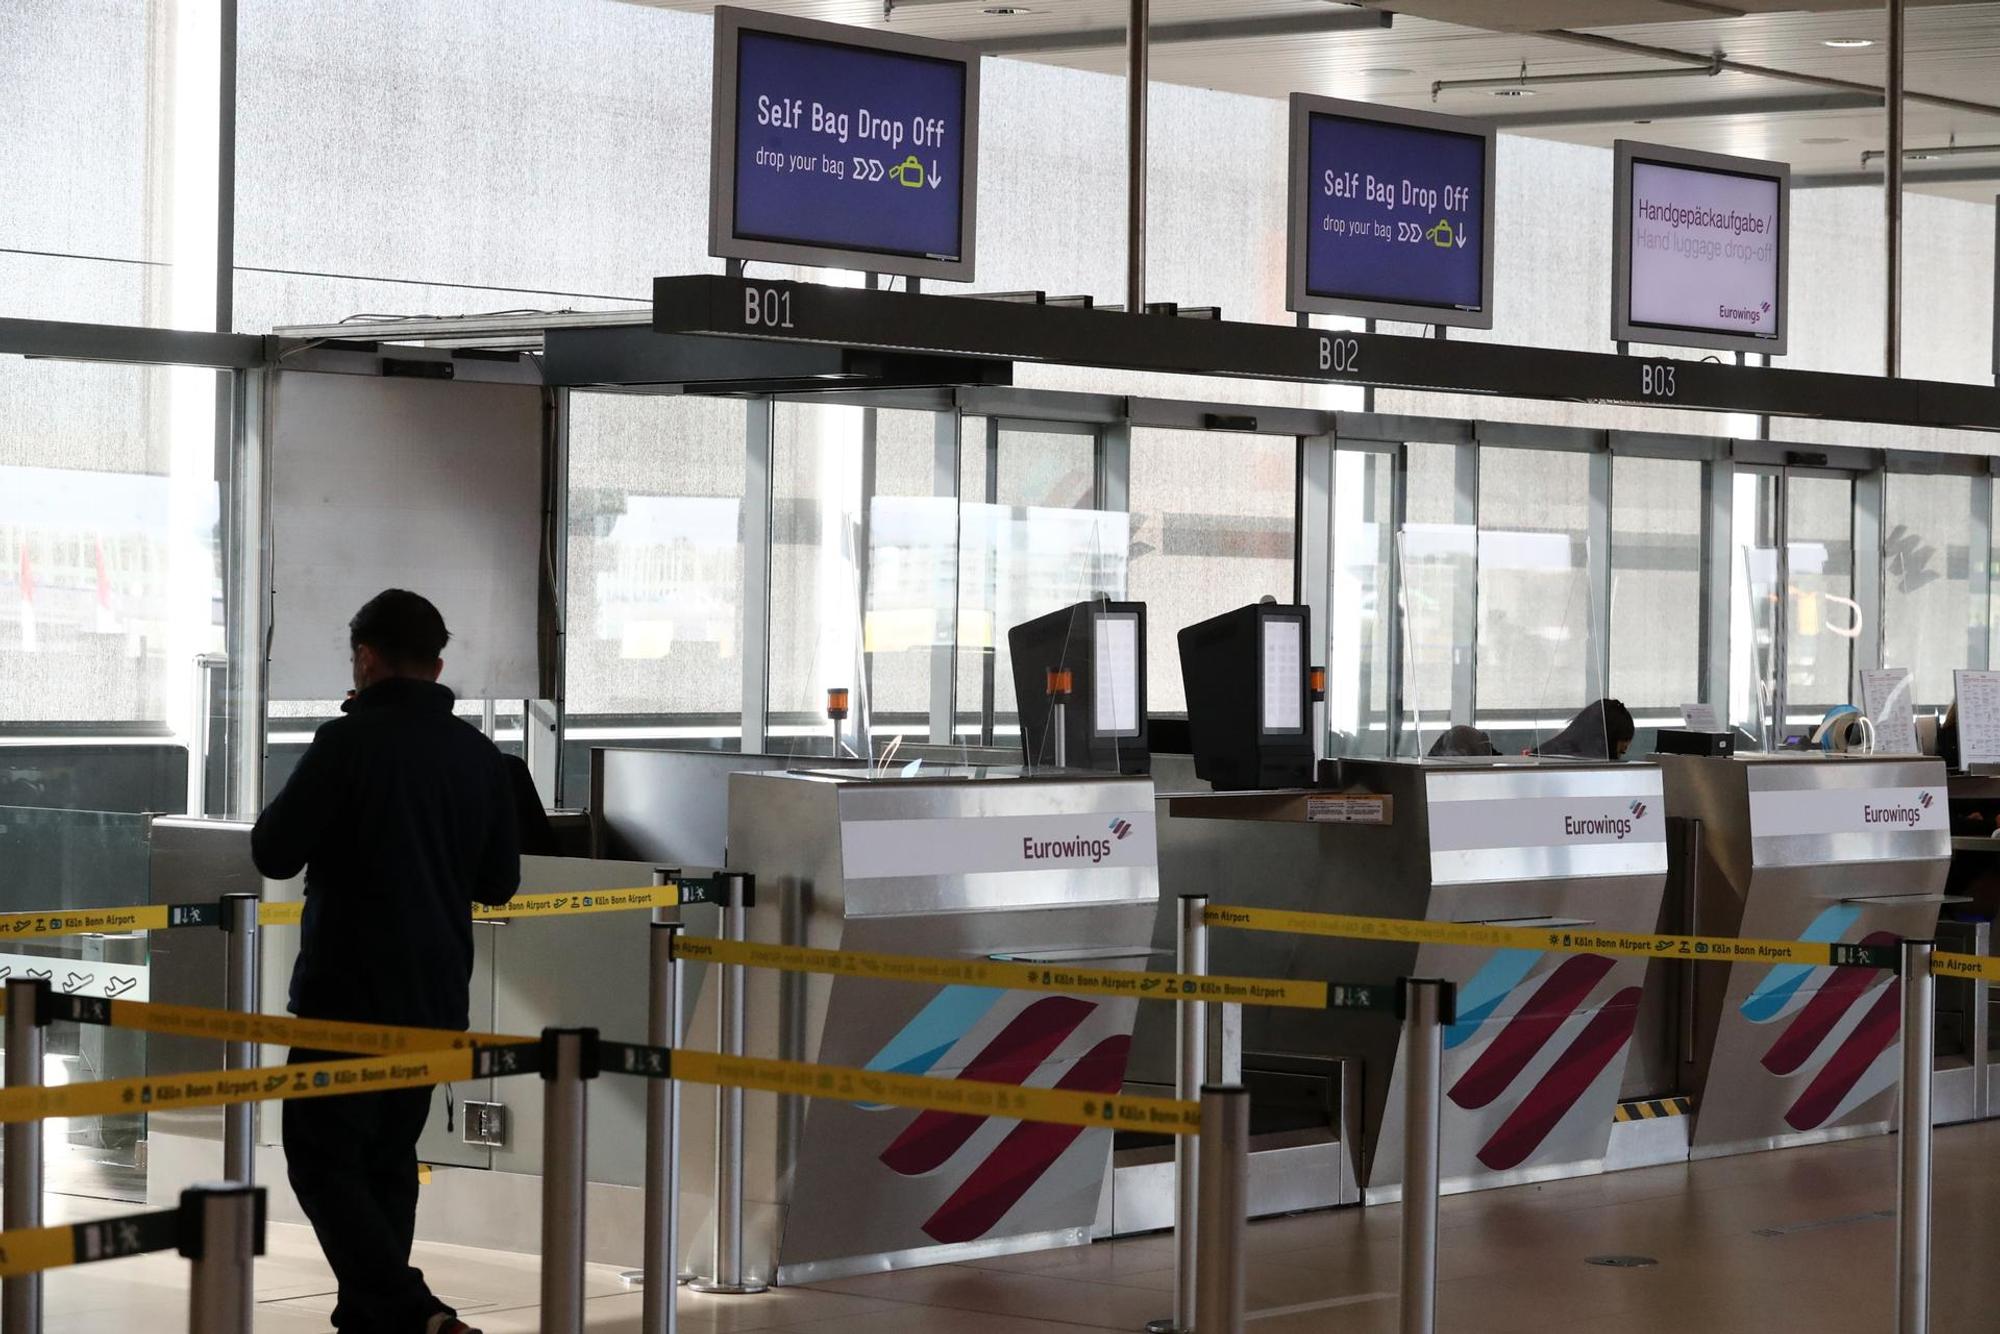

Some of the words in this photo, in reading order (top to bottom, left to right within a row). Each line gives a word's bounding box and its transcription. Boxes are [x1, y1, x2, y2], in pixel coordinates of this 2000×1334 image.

[757, 95, 802, 129] Self
[811, 102, 849, 143] Bag
[858, 109, 903, 149] Drop
[913, 116, 945, 148] Off
[756, 146, 784, 172] drop
[789, 154, 817, 173] your
[822, 154, 845, 180] bag
[1324, 169, 1359, 199] Self
[1366, 175, 1395, 210] Bag
[1402, 180, 1437, 214] Drop
[1444, 185, 1469, 212] Off
[1323, 215, 1346, 237] drop
[1349, 221, 1370, 236] your
[1374, 220, 1392, 242] bag
[1638, 198, 1764, 236] Handgepäckaufgabe
[1636, 228, 1670, 251] Hand
[1673, 233, 1721, 261] luggage
[1724, 240, 1772, 265] drop-off
[744, 287, 794, 328] B01
[1719, 305, 1761, 324] Eurowings
[1319, 337, 1359, 373] B02
[1642, 364, 1676, 397] B03
[1564, 814, 1632, 840] Eurowings
[1864, 804, 1920, 827] Eurowings
[1023, 835, 1111, 863] Eurowings
[526, 899, 551, 911] Airport
[628, 893, 652, 904] Airport
[106, 914, 136, 926] Airport
[1574, 935, 1593, 947] Köln
[1595, 937, 1617, 949] Bonn
[1619, 937, 1652, 951] Airport
[1711, 943, 1732, 954] Köln
[1734, 944, 1756, 955] Bonn
[1758, 945, 1792, 958] Airport
[1947, 958, 1983, 973] Airport
